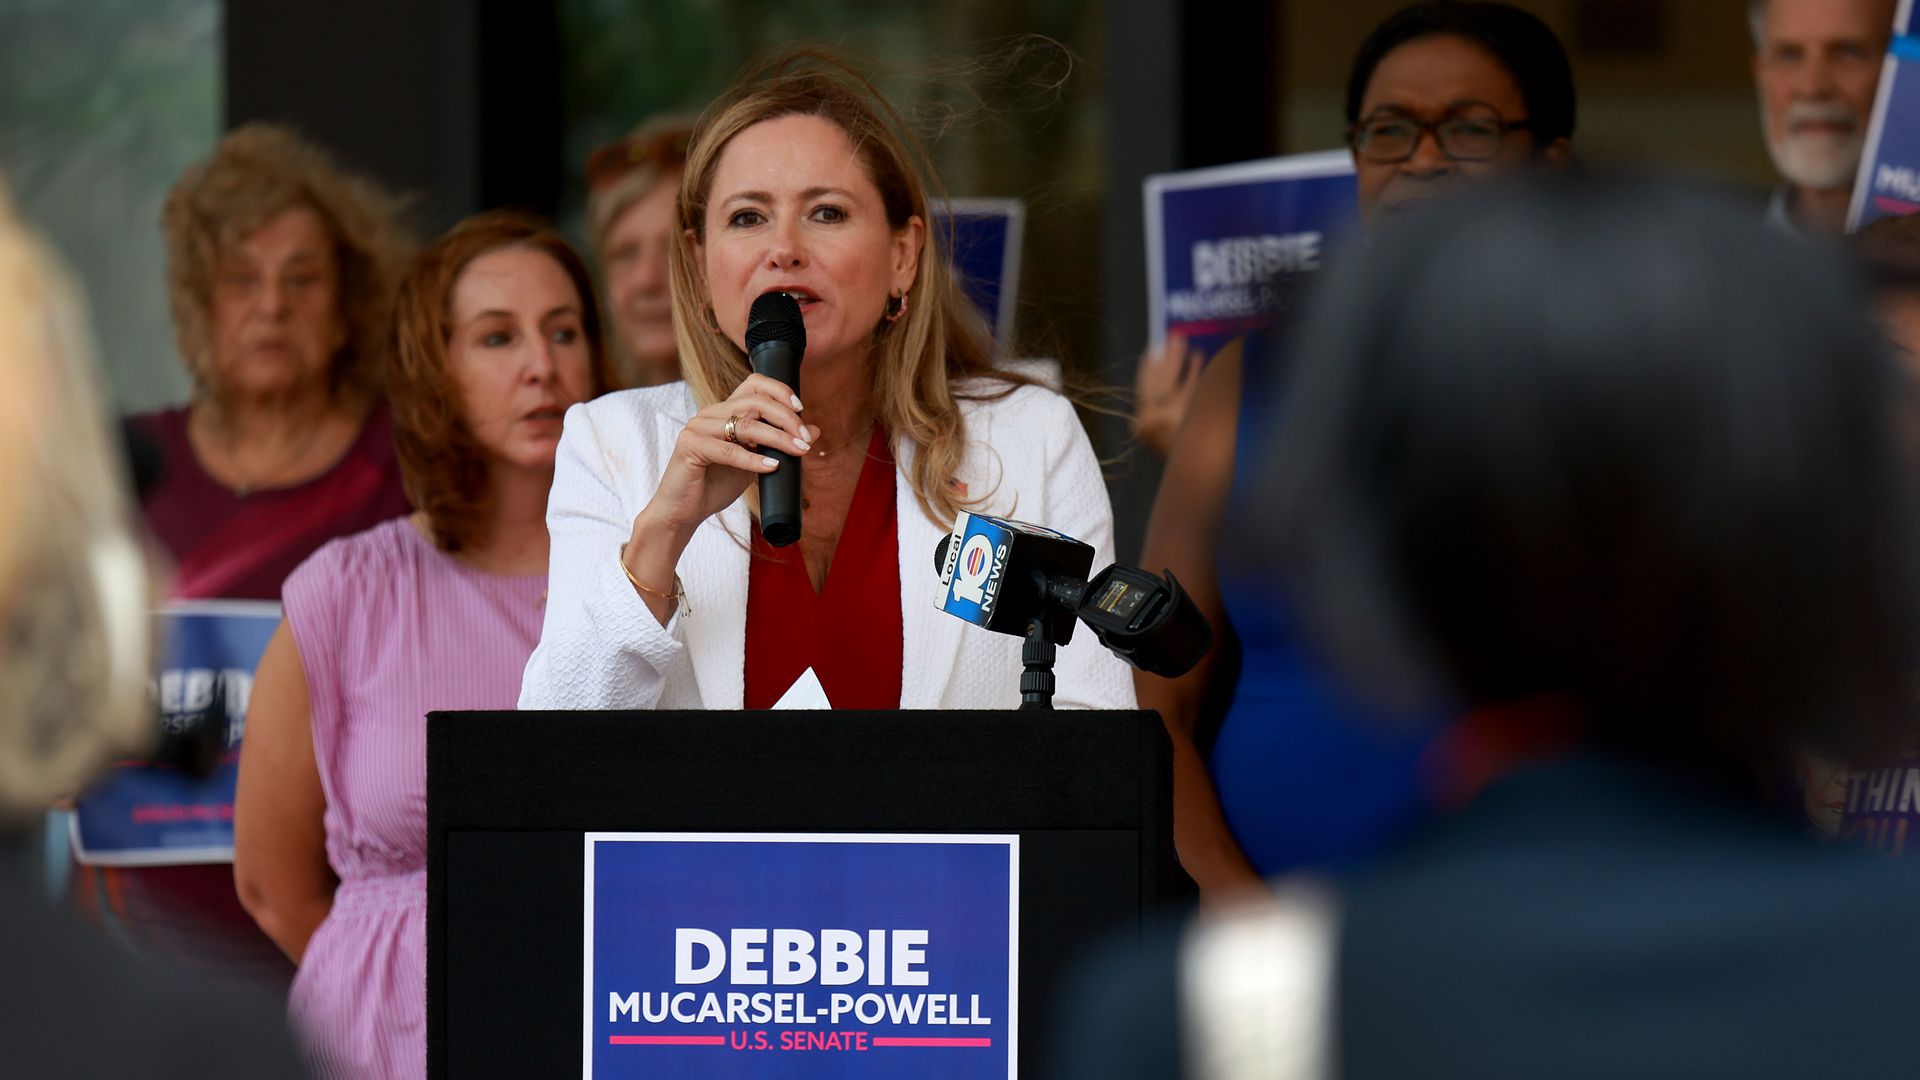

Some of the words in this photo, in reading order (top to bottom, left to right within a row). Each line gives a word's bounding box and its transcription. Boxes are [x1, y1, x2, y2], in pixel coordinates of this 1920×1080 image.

[942, 535, 961, 586] Local
[953, 535, 993, 604] 10
[981, 545, 1006, 612] NEWS
[674, 928, 930, 985] DEBBIE
[609, 991, 991, 1025] MUCARSEL-POWELL
[730, 1030, 773, 1050] U.S.
[780, 1031, 868, 1050] SENATE
